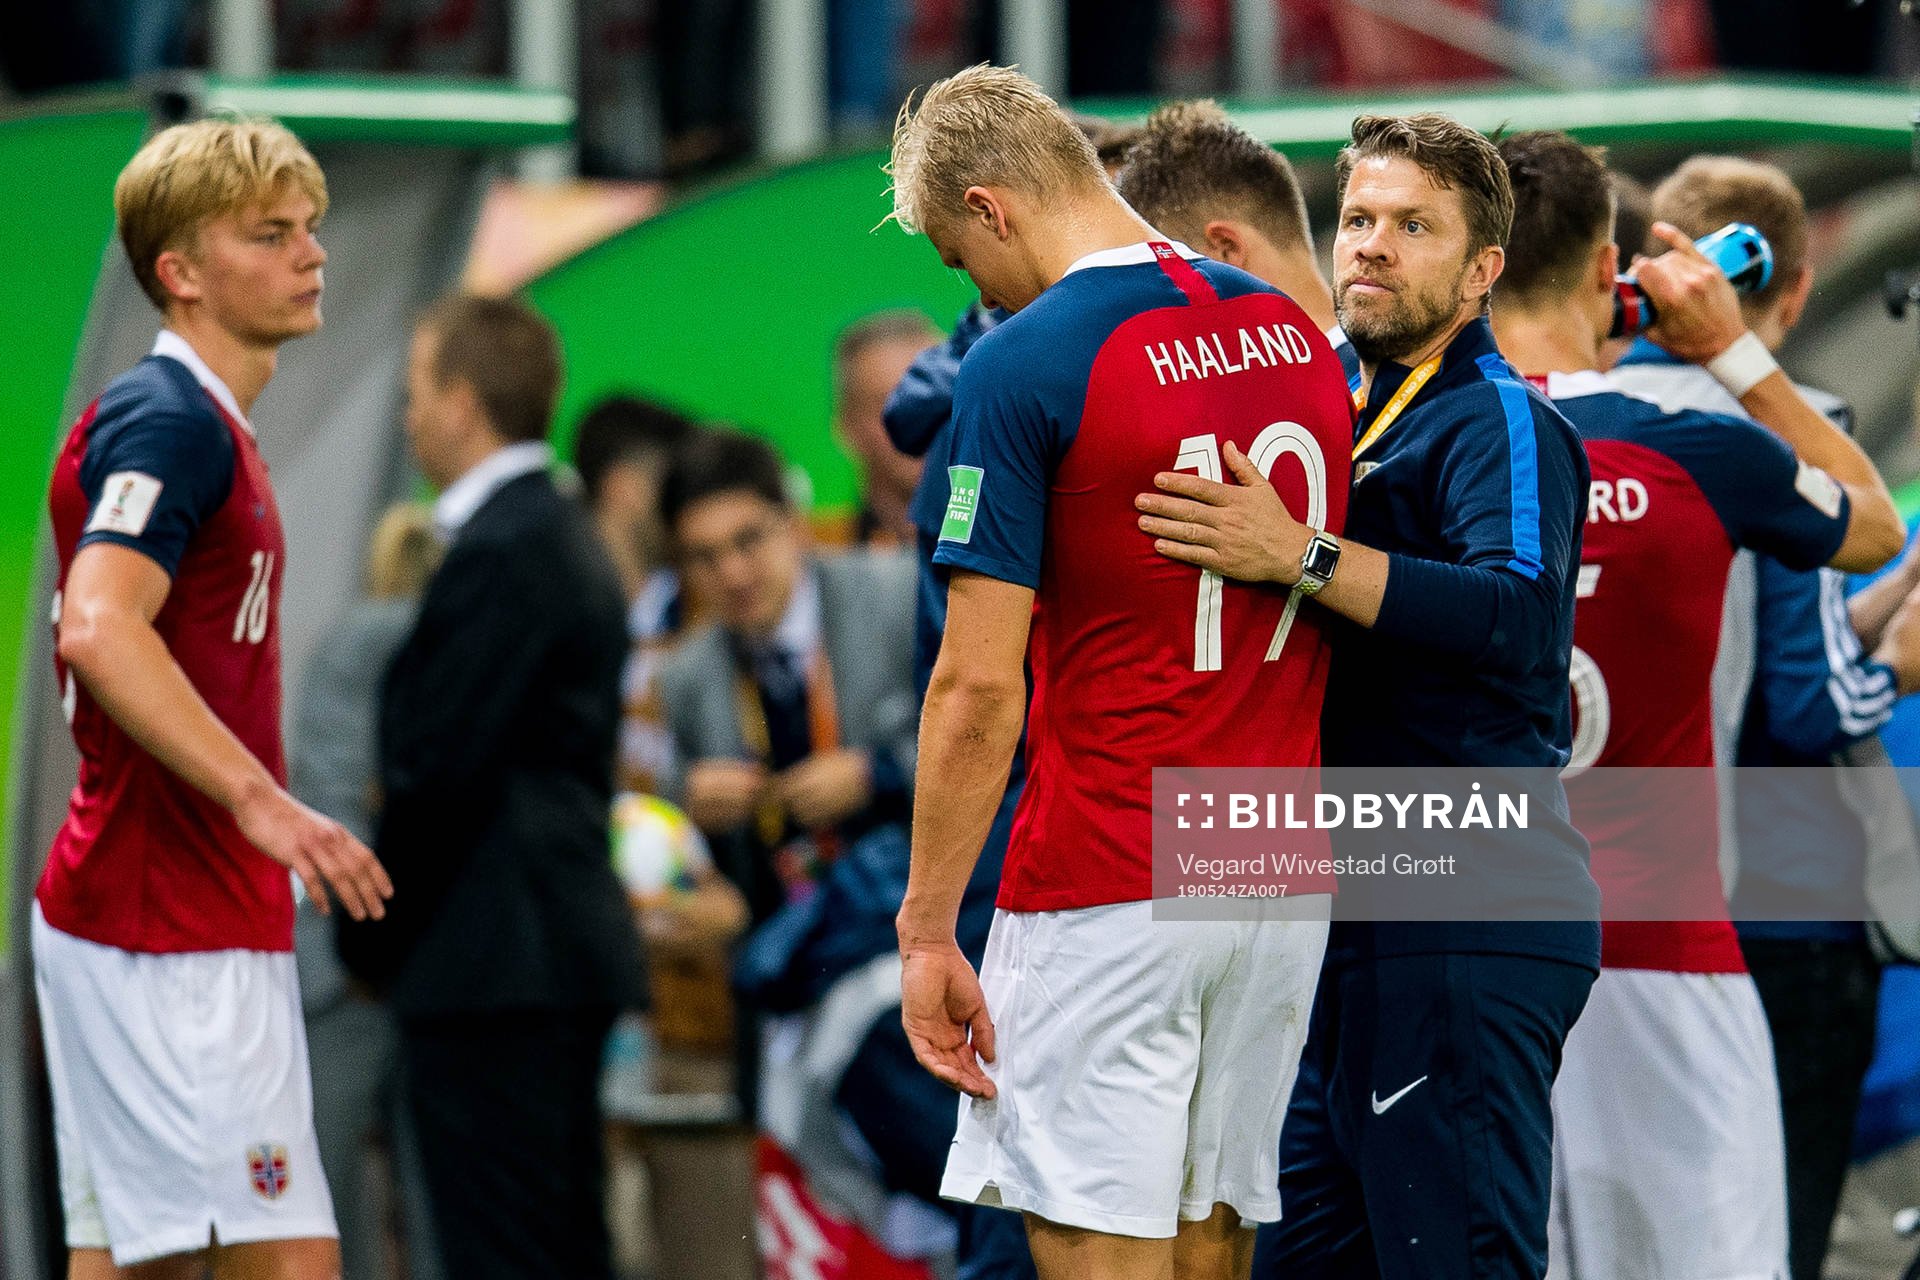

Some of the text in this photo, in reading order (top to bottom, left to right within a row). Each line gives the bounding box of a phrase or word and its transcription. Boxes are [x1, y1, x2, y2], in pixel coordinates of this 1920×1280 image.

[1144, 323, 1312, 386] HAALAND
[949, 510, 970, 522] FIFA
[1585, 478, 1649, 523] RD
[1173, 421, 1327, 672] 19
[232, 550, 275, 645] 16
